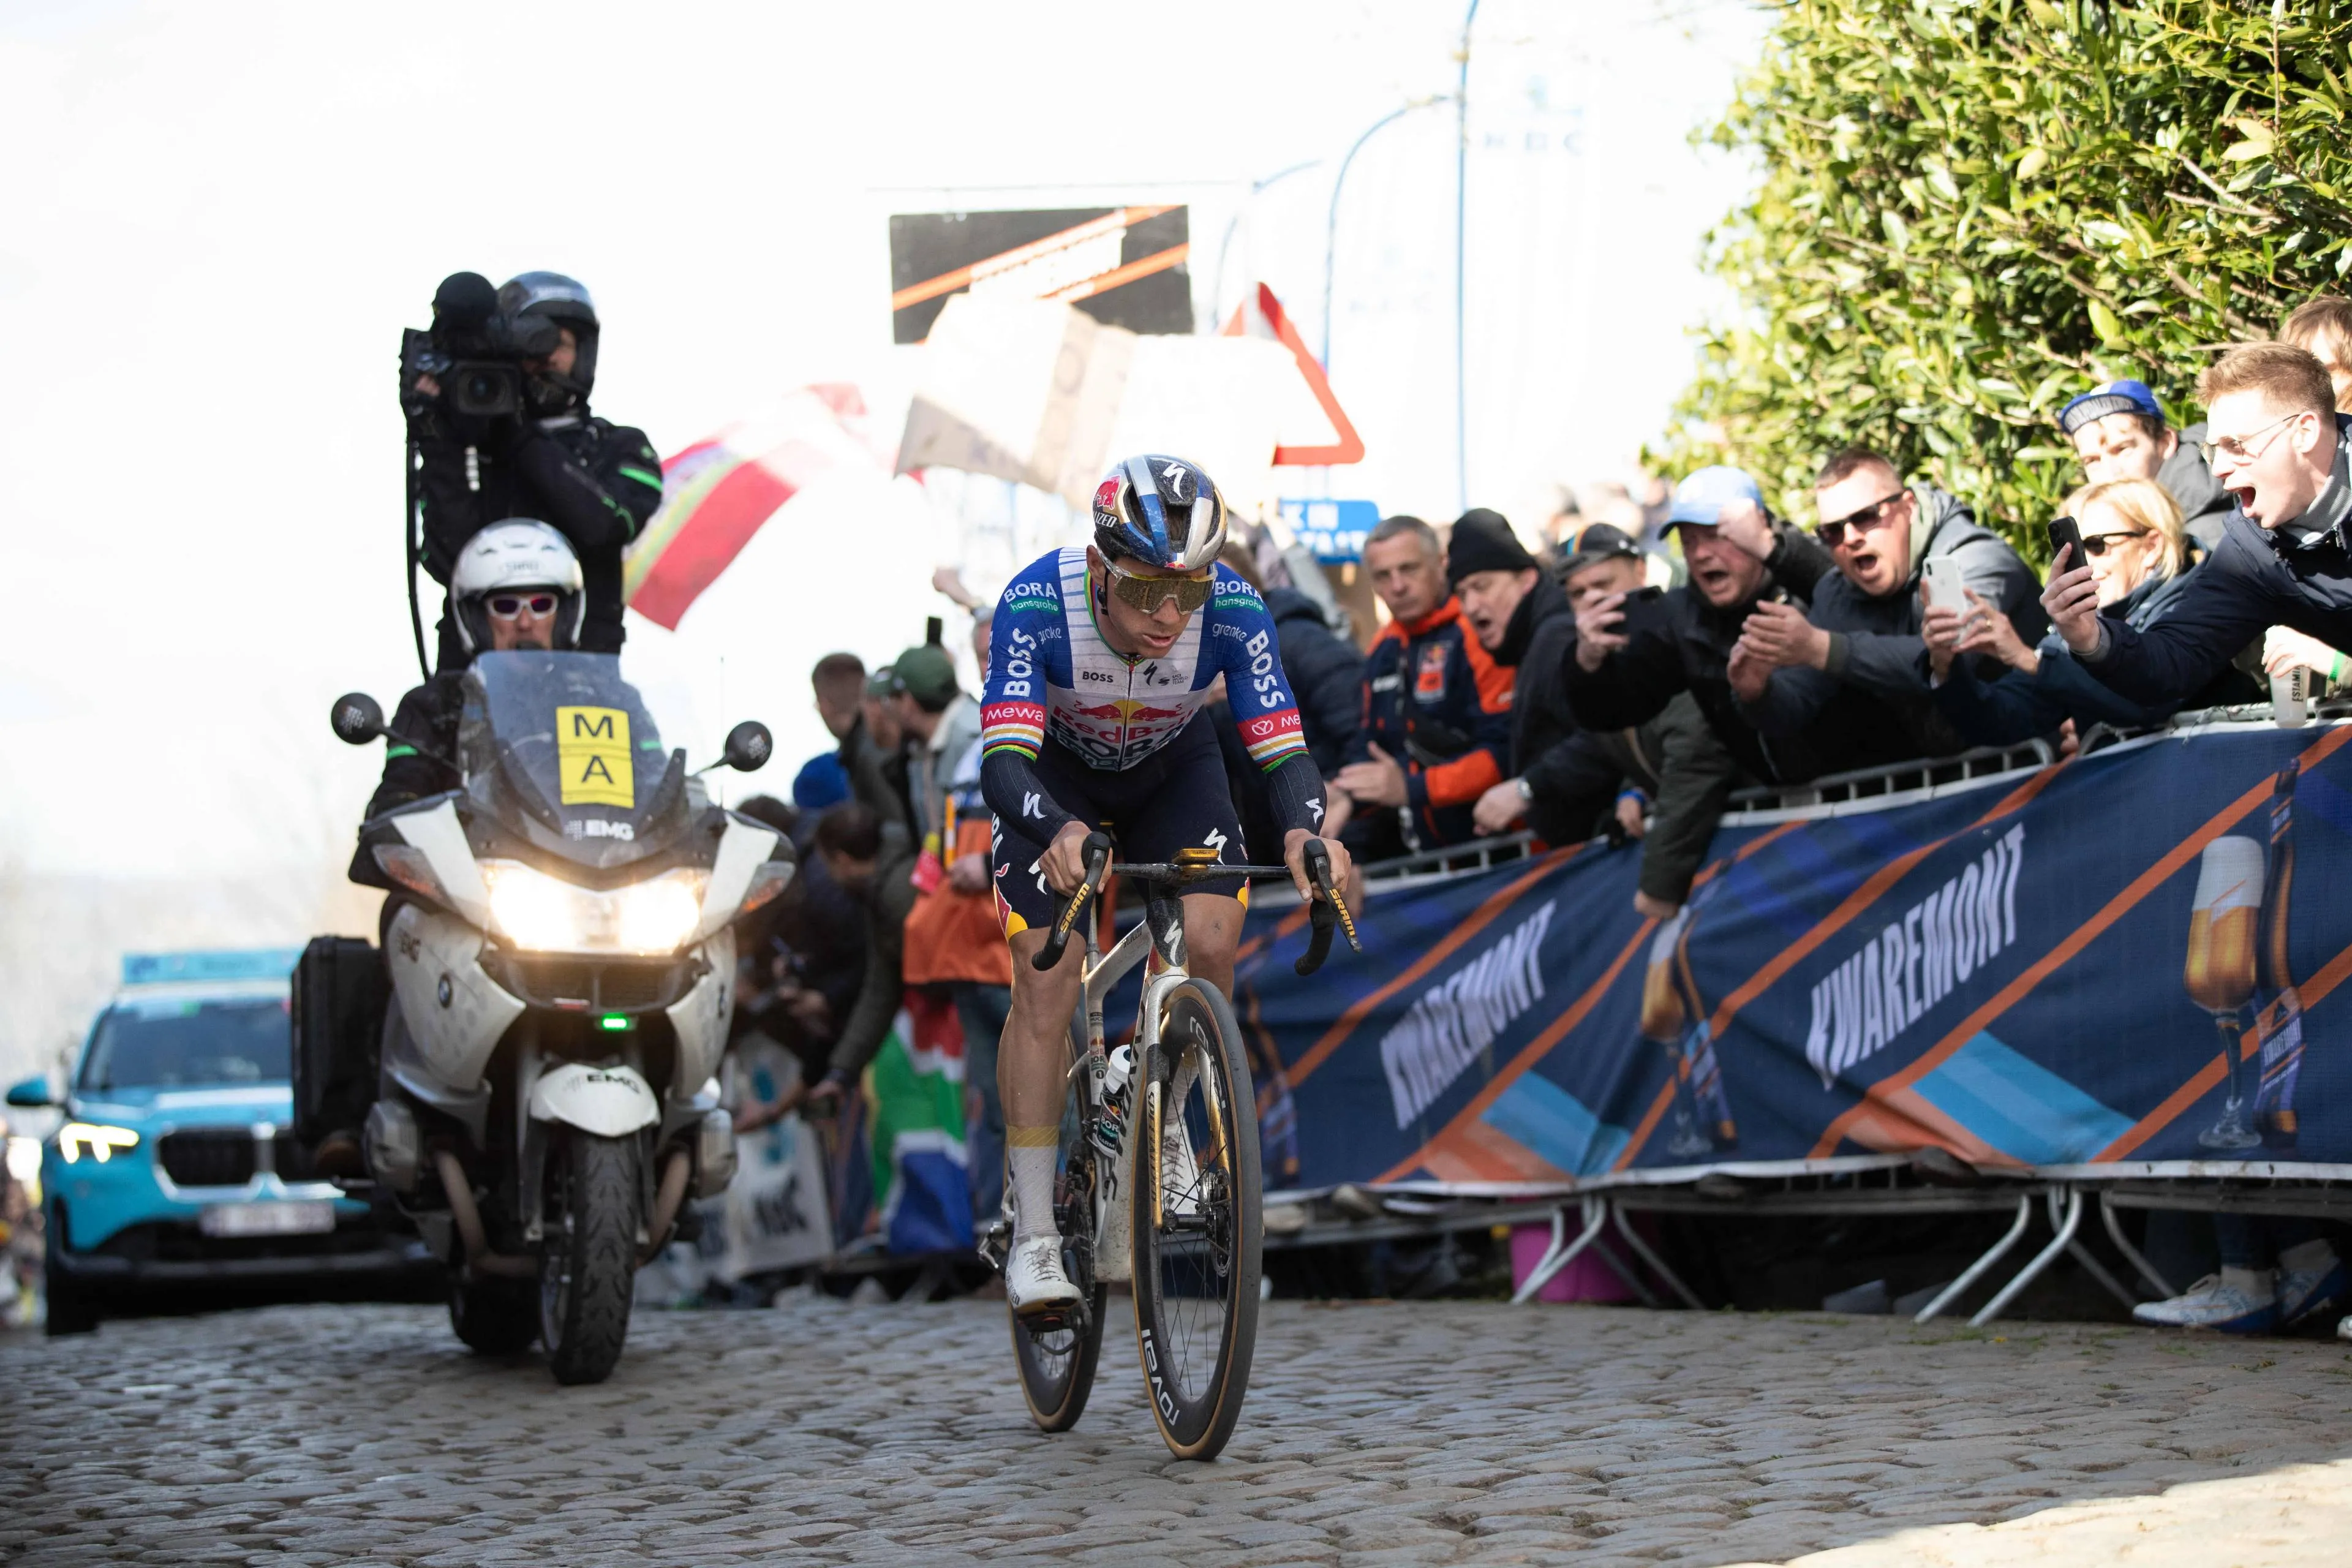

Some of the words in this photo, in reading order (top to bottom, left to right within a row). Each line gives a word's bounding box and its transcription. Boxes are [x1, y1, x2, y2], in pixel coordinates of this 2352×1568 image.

[1003, 582, 1058, 603] BORA
[1011, 598, 1059, 612] hansgrohe
[1215, 581, 1264, 603] BORA
[1215, 597, 1264, 611] hansgrohe
[1212, 623, 1248, 642] grenke
[1003, 627, 1036, 697] BOSS
[1245, 628, 1286, 708] BOSS
[1082, 671, 1114, 684] BOSS
[2291, 667, 2304, 702] ESTAMI
[574, 713, 614, 739] M
[581, 755, 614, 785] A
[586, 819, 635, 841] EMG
[1060, 883, 1090, 933] SRAM
[1329, 888, 1355, 936] SRAM
[1806, 821, 2026, 1092] KWAREMONT
[1141, 1329, 1180, 1426] roval
